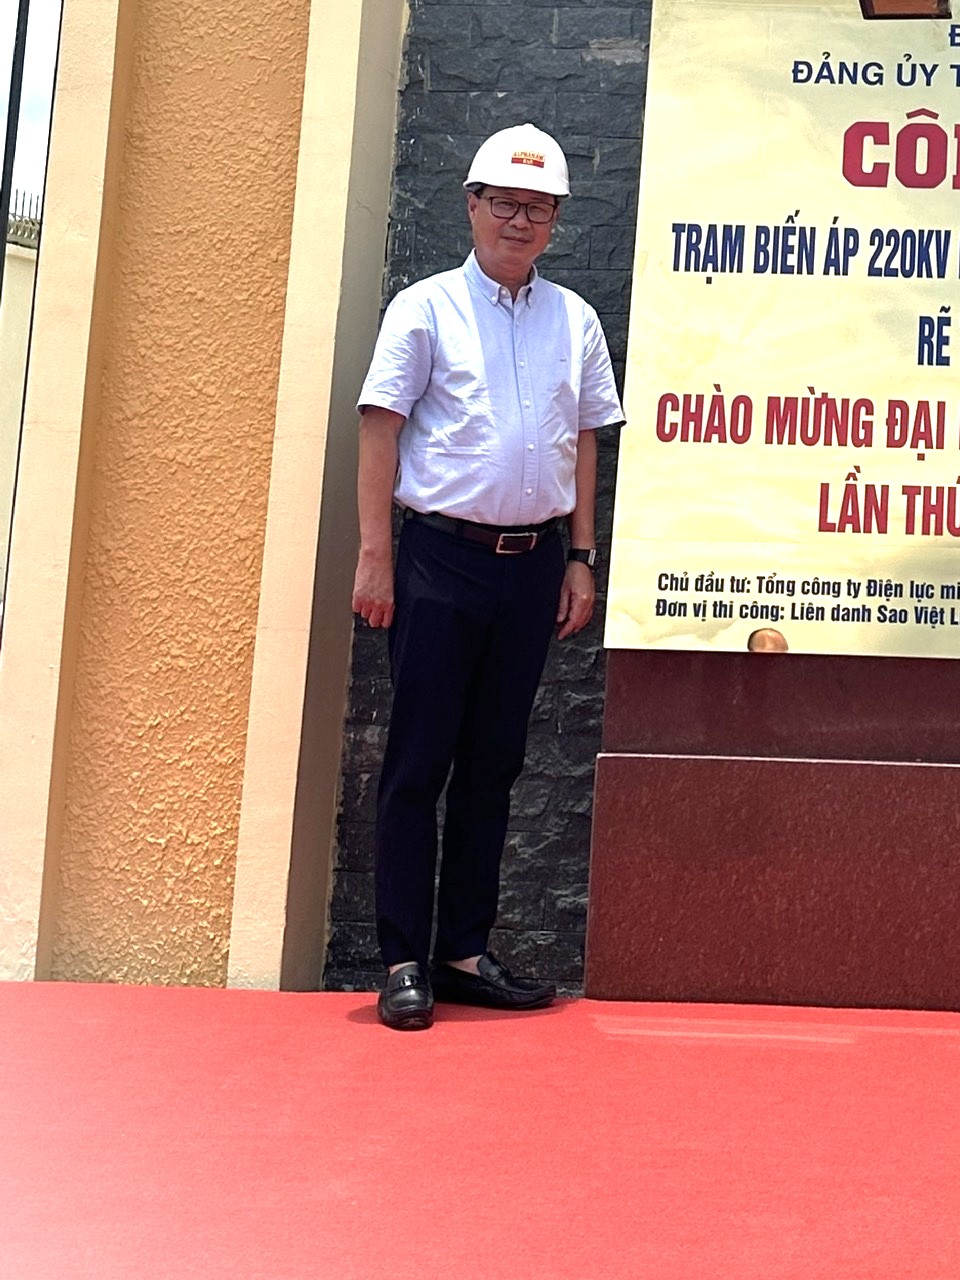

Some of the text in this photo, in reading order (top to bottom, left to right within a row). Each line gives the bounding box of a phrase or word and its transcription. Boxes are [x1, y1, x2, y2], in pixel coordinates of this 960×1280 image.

[792, 52, 883, 85] ĐẢNG
[897, 54, 939, 86] ỦY
[672, 223, 745, 284] TRẠM
[753, 210, 816, 275] BIẾN
[823, 216, 859, 276] ÁP
[868, 229, 951, 278] 220KV
[918, 306, 951, 366] RẼ
[656, 384, 753, 444] CHÀO
[765, 387, 874, 448] MỪNG
[886, 400, 945, 461] ĐẠI
[818, 466, 889, 534] LẦN
[656, 599, 687, 617] Đơn
[693, 600, 707, 621] vị
[713, 601, 733, 618] thi
[740, 601, 784, 622] công:
[791, 602, 825, 621] Liên
[831, 604, 871, 622] danh
[877, 605, 908, 623] Sao
[914, 606, 945, 629] Việt
[658, 571, 689, 592] Chủ
[694, 571, 724, 592] đầu
[730, 576, 750, 593] tư:
[757, 573, 795, 596] Tổng
[801, 577, 841, 598] công
[847, 579, 861, 598] ty
[866, 579, 903, 601] Điện
[910, 580, 934, 603] lực
